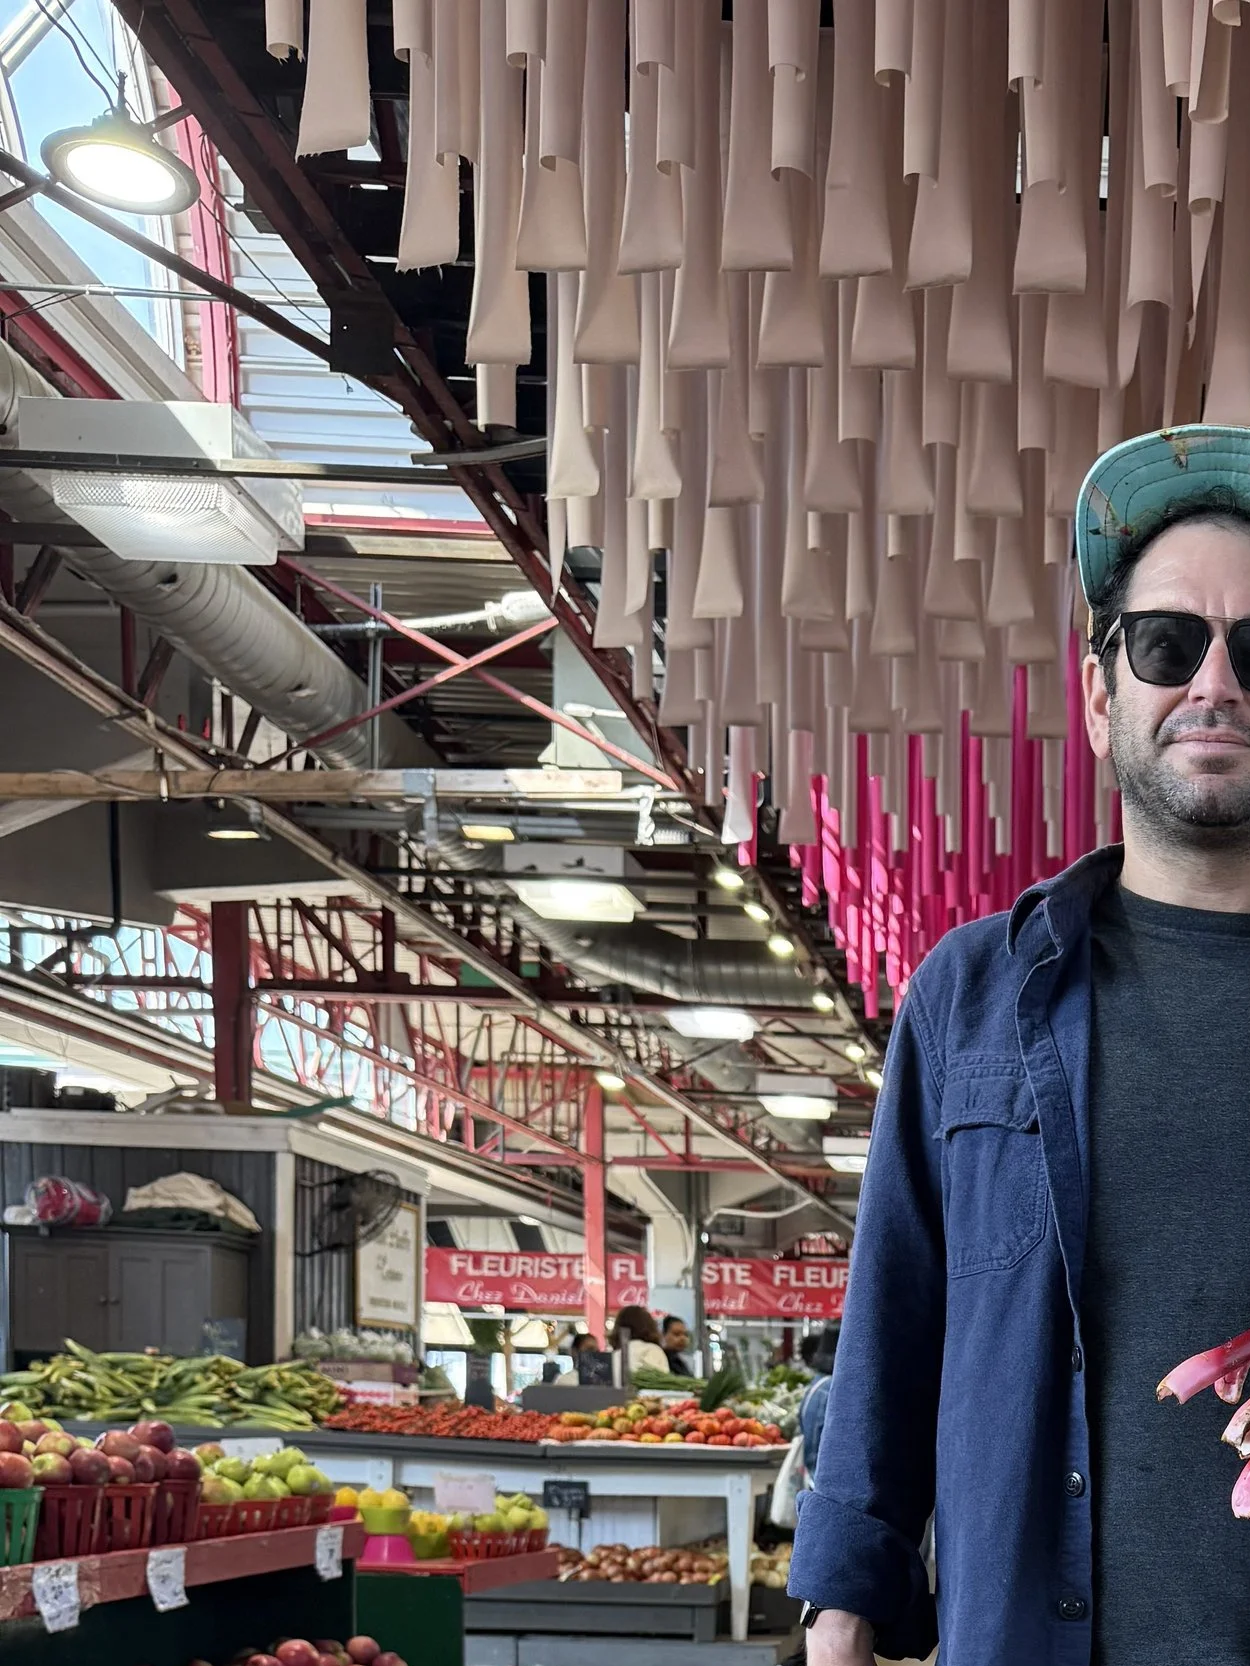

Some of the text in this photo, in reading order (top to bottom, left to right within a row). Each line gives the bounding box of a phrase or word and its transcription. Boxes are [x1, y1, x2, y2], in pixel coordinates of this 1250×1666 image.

[451, 1254, 584, 1279] FLEURISTE
[457, 1280, 503, 1302] Chez
[510, 1281, 583, 1304] Daniel
[776, 1292, 824, 1314] Chez
